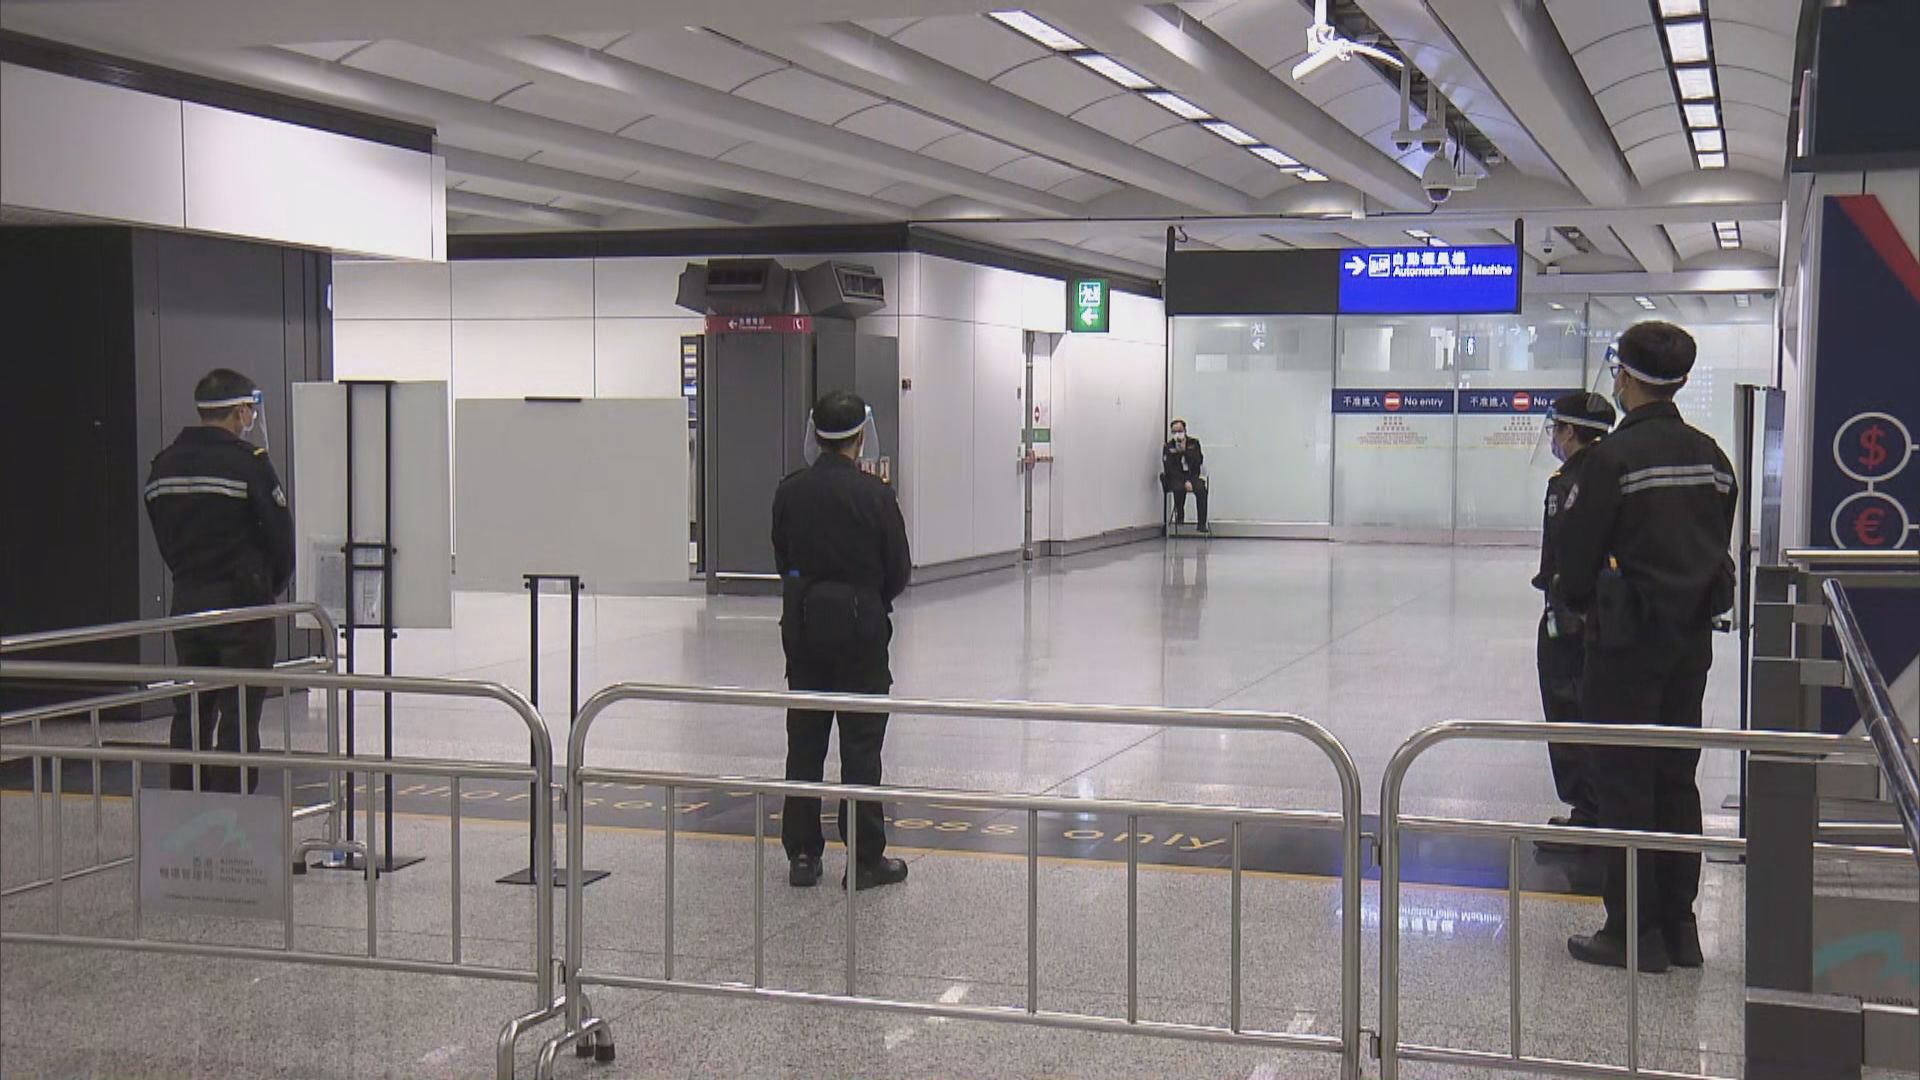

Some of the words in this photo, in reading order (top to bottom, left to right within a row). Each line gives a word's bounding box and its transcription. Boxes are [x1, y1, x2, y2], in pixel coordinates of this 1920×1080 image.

[1393, 265, 1444, 277] Automated
[1445, 264, 1470, 275] Teller
[1472, 264, 1513, 275] Machine
[1404, 396, 1418, 406] No
[1420, 396, 1444, 408] entry
[1533, 396, 1547, 406] No
[1858, 424, 1888, 471] $
[1855, 507, 1887, 546] €
[1063, 828, 1226, 851] only
